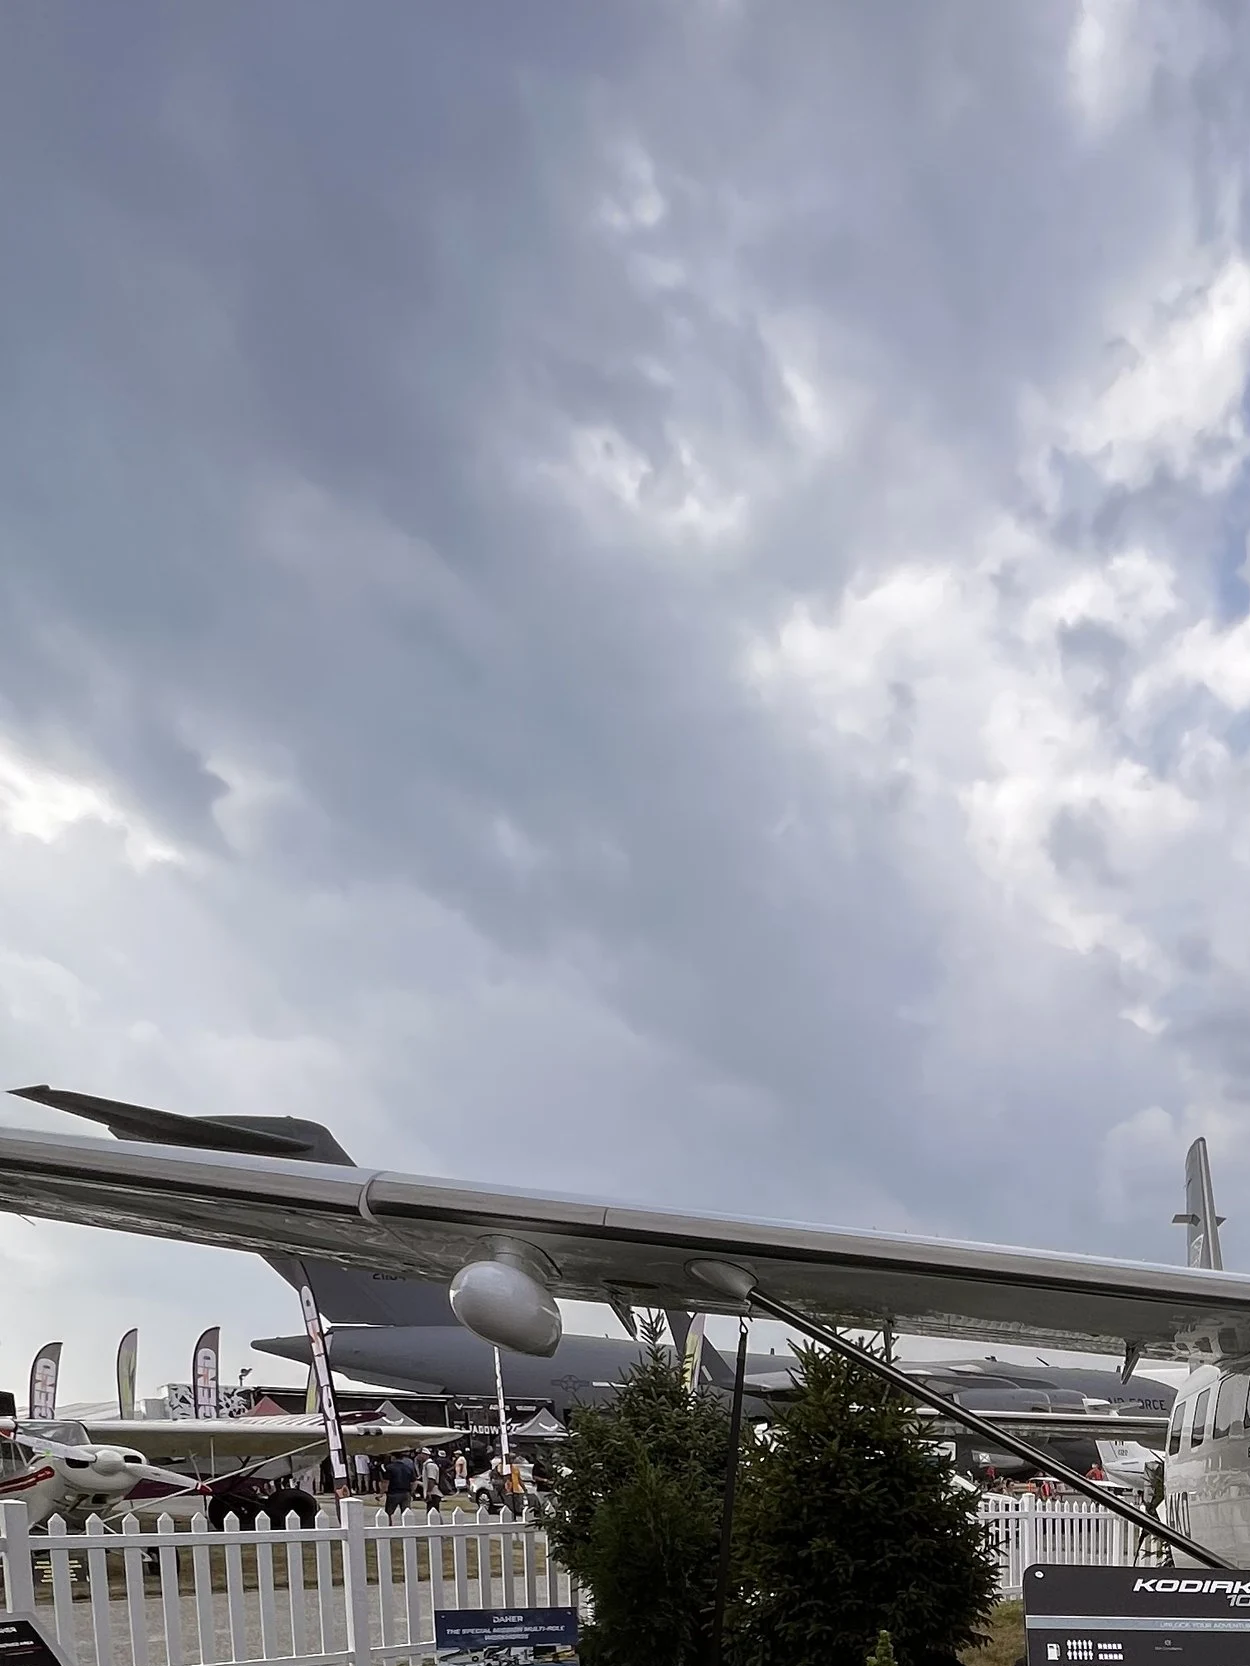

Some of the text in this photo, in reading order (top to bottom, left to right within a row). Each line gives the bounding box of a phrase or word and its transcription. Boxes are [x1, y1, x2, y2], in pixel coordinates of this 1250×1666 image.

[34, 1361, 56, 1419] GEND
[197, 1349, 217, 1419] GEND
[1129, 1399, 1167, 1410] ORCE
[492, 1615, 524, 1623] DAHER
